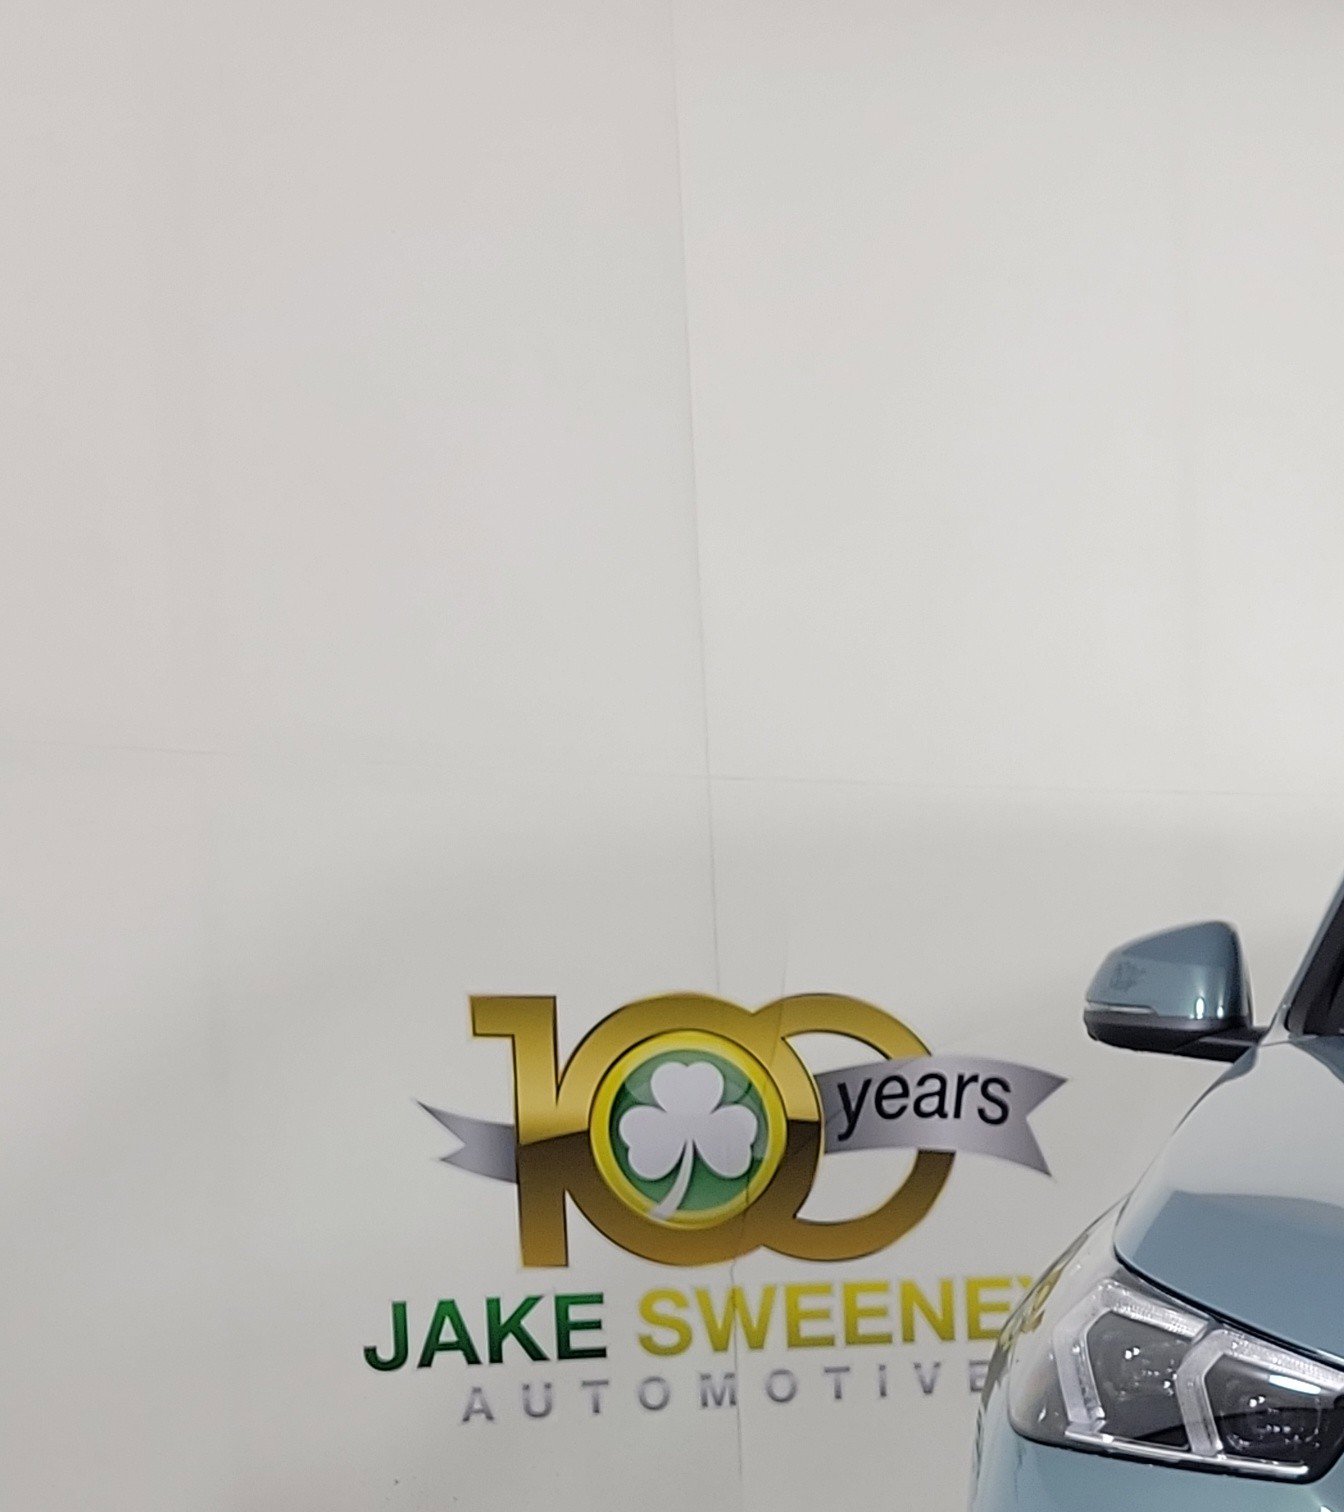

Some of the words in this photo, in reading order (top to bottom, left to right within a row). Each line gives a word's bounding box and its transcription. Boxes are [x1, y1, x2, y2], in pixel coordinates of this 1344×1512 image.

[836, 1071, 1013, 1141] years
[363, 1293, 608, 1372] JAKE
[637, 1275, 1034, 1357] SWEENE
